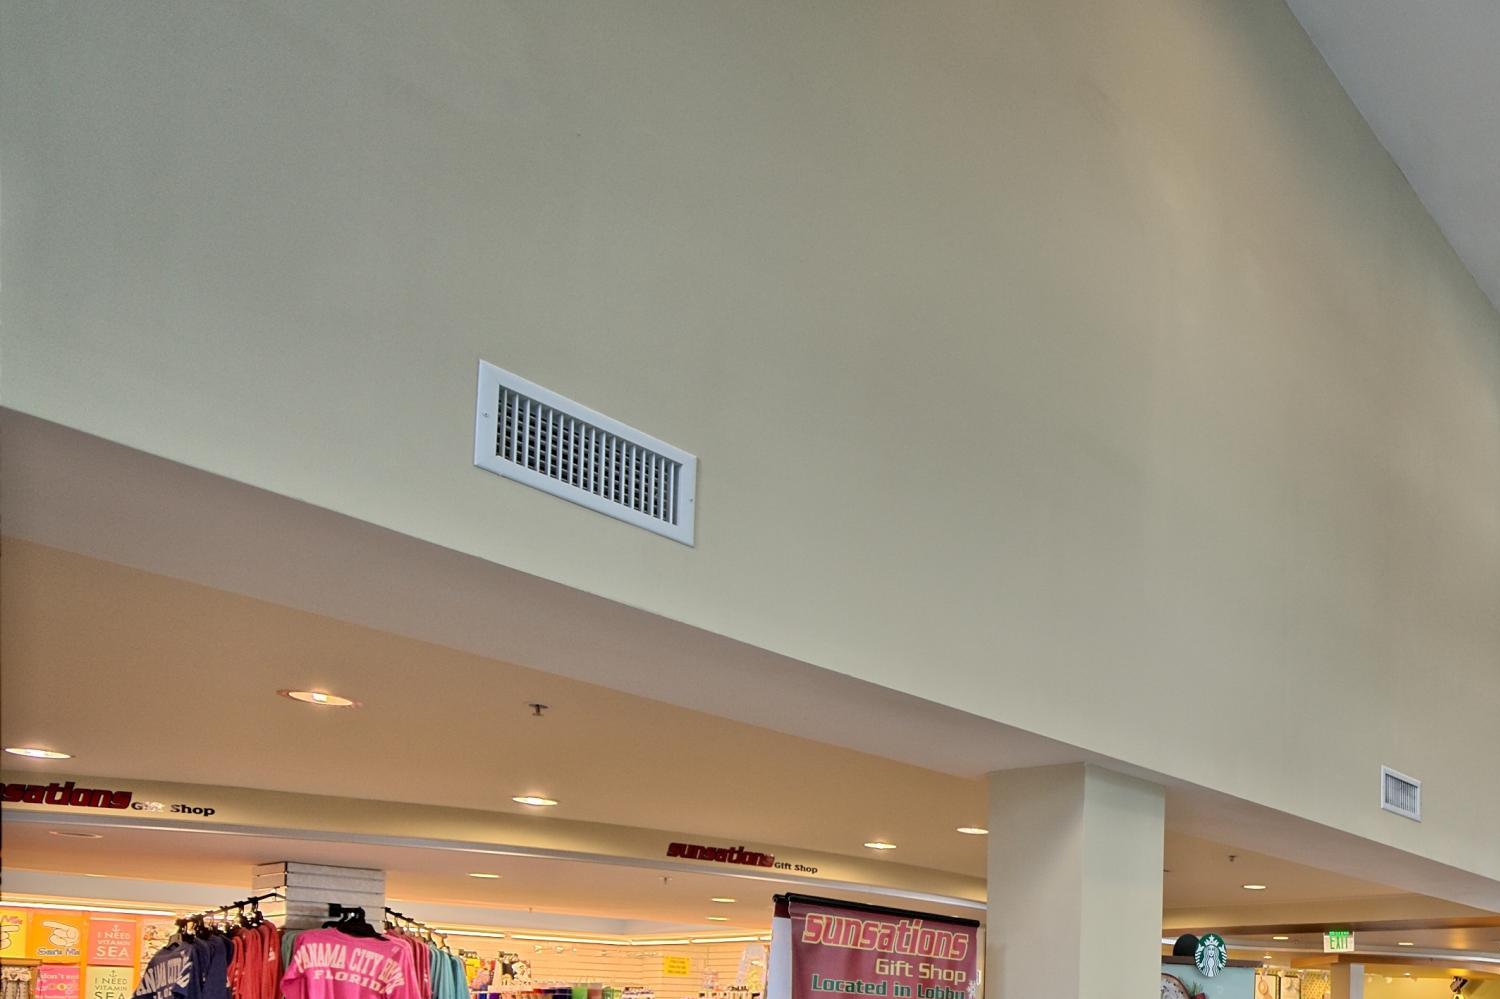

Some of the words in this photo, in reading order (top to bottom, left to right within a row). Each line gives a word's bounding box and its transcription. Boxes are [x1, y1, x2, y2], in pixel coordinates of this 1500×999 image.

[0, 781, 132, 809] sations
[170, 804, 215, 817] Shop
[666, 842, 775, 868] sunsations
[774, 862, 792, 871] Gift
[794, 864, 818, 874] Shop
[802, 912, 969, 961] sunsations
[1329, 935, 1349, 950] EXIT
[96, 945, 129, 957] SEA
[294, 942, 347, 974] PANAMA
[349, 947, 384, 977] CITY
[313, 969, 386, 994] FLORID
[812, 974, 887, 997] Located
[893, 981, 911, 998] in
[875, 958, 914, 978] Gift
[918, 962, 967, 986] Shop
